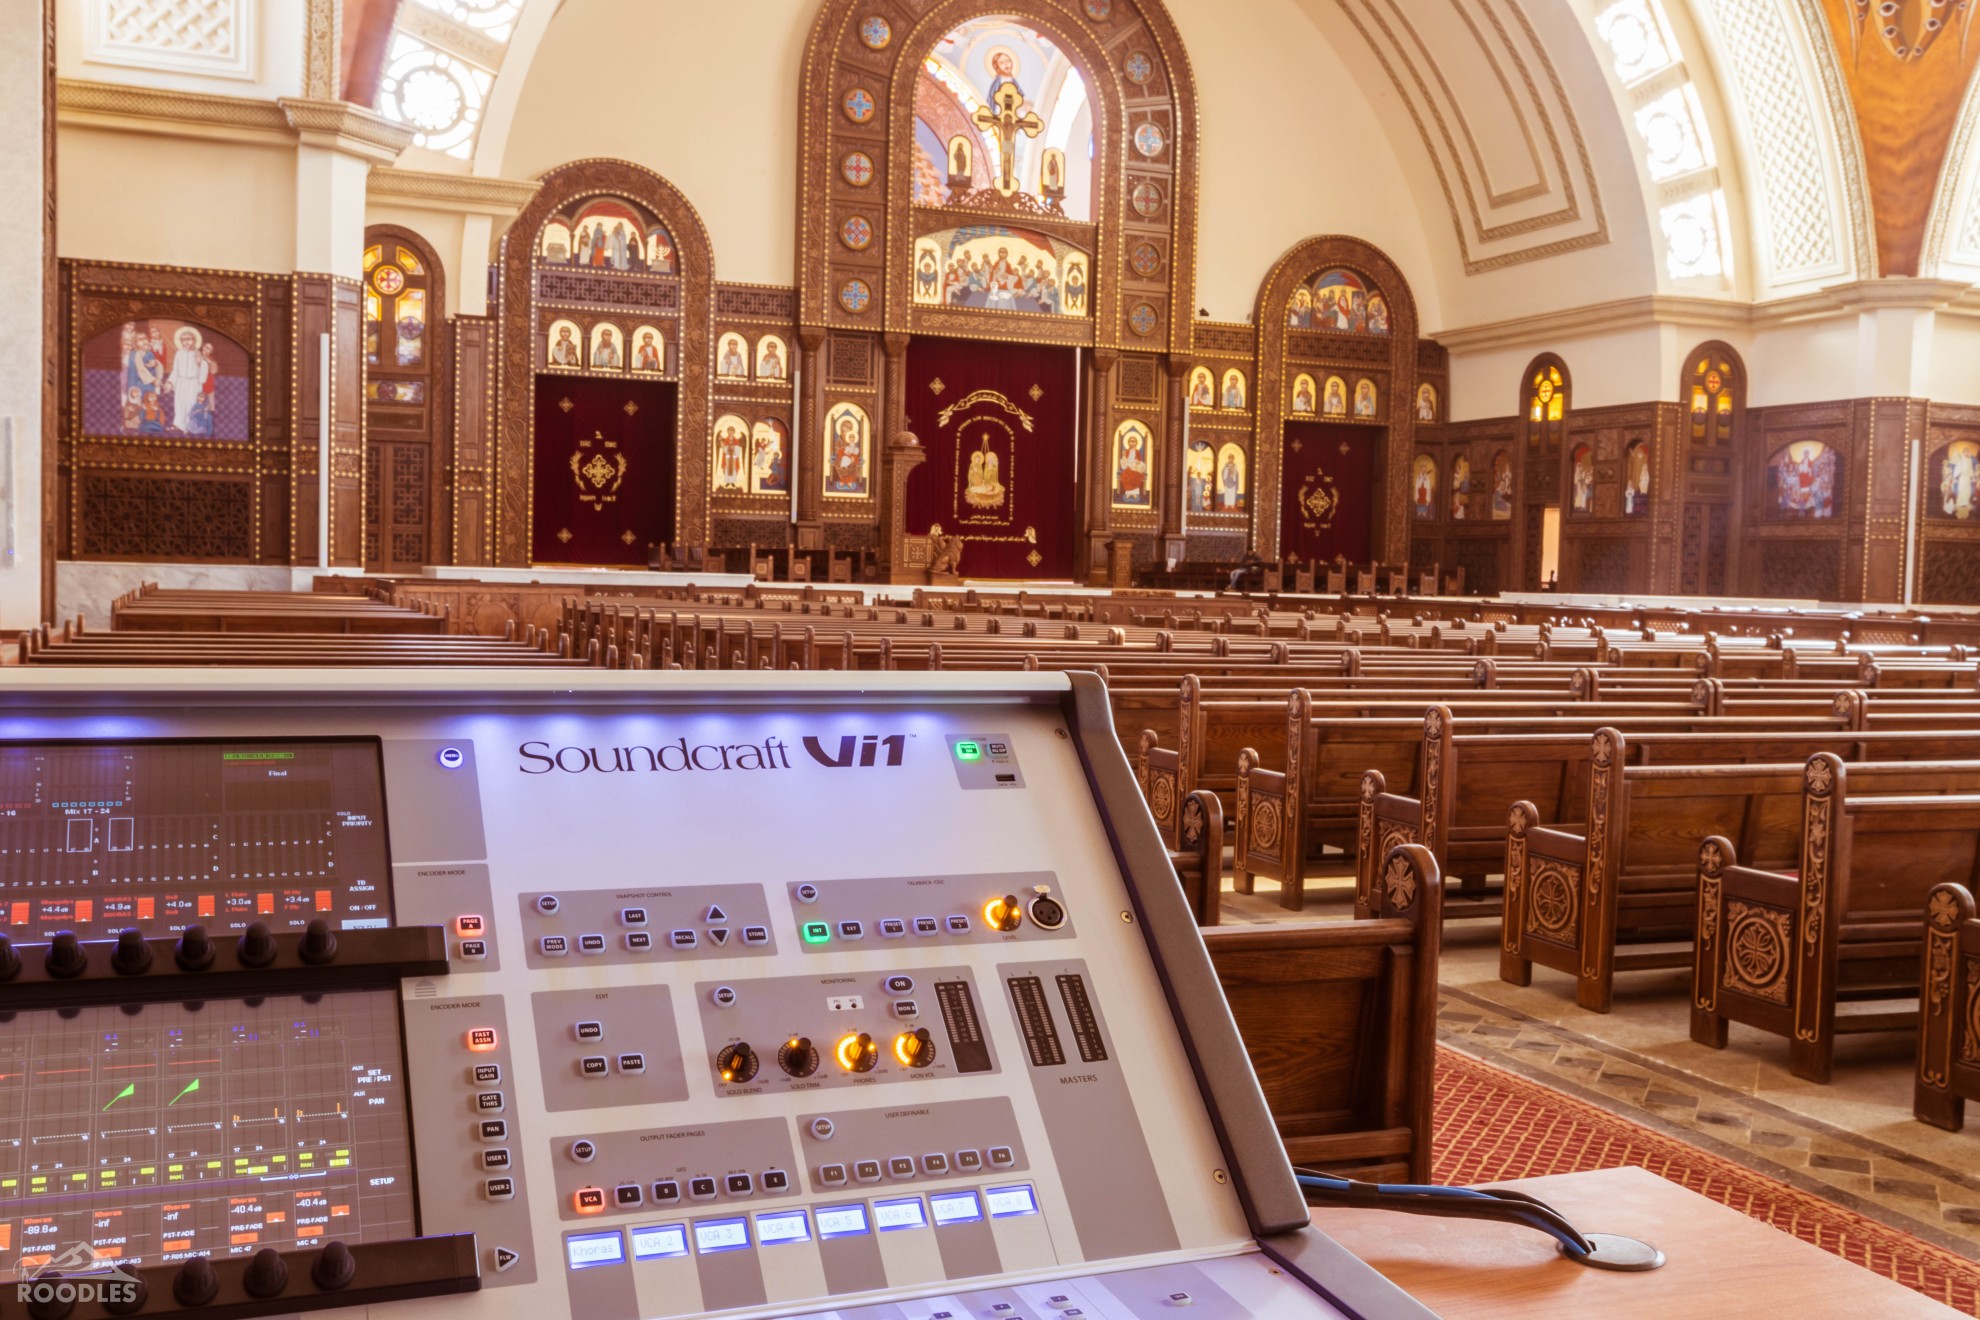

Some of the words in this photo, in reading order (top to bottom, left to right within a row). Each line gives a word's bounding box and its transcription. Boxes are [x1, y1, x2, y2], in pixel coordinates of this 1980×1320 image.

[518, 736, 792, 774] Soundcraft
[1060, 1074, 1098, 1085] MASTERS
[900, 1109, 930, 1117] DEFINABLE
[370, 1177, 394, 1186] SETUP
[993, 1197, 1011, 1208] VCA
[1016, 1195, 1022, 1205] 8
[936, 1204, 953, 1214] VCA
[958, 1202, 964, 1212] 7
[164, 1212, 178, 1220] -inf
[881, 1210, 899, 1221] VCA
[905, 1208, 912, 1218] 6
[95, 1219, 110, 1227] -inf
[297, 1216, 328, 1225] PRE-FADE
[820, 1217, 840, 1227] VCA
[846, 1215, 852, 1225] 5
[231, 1223, 263, 1231] PRE-FADE
[764, 1224, 783, 1234] VCA
[789, 1221, 795, 1231] 4
[163, 1230, 195, 1238] PST-FADE
[701, 1231, 721, 1241] VCA
[727, 1229, 733, 1238] 3
[94, 1237, 126, 1246] PST-FADE
[640, 1237, 662, 1248] VCA
[668, 1236, 673, 1245] 2
[23, 1245, 56, 1253] PST-FADE
[573, 1243, 614, 1257] Khoras
